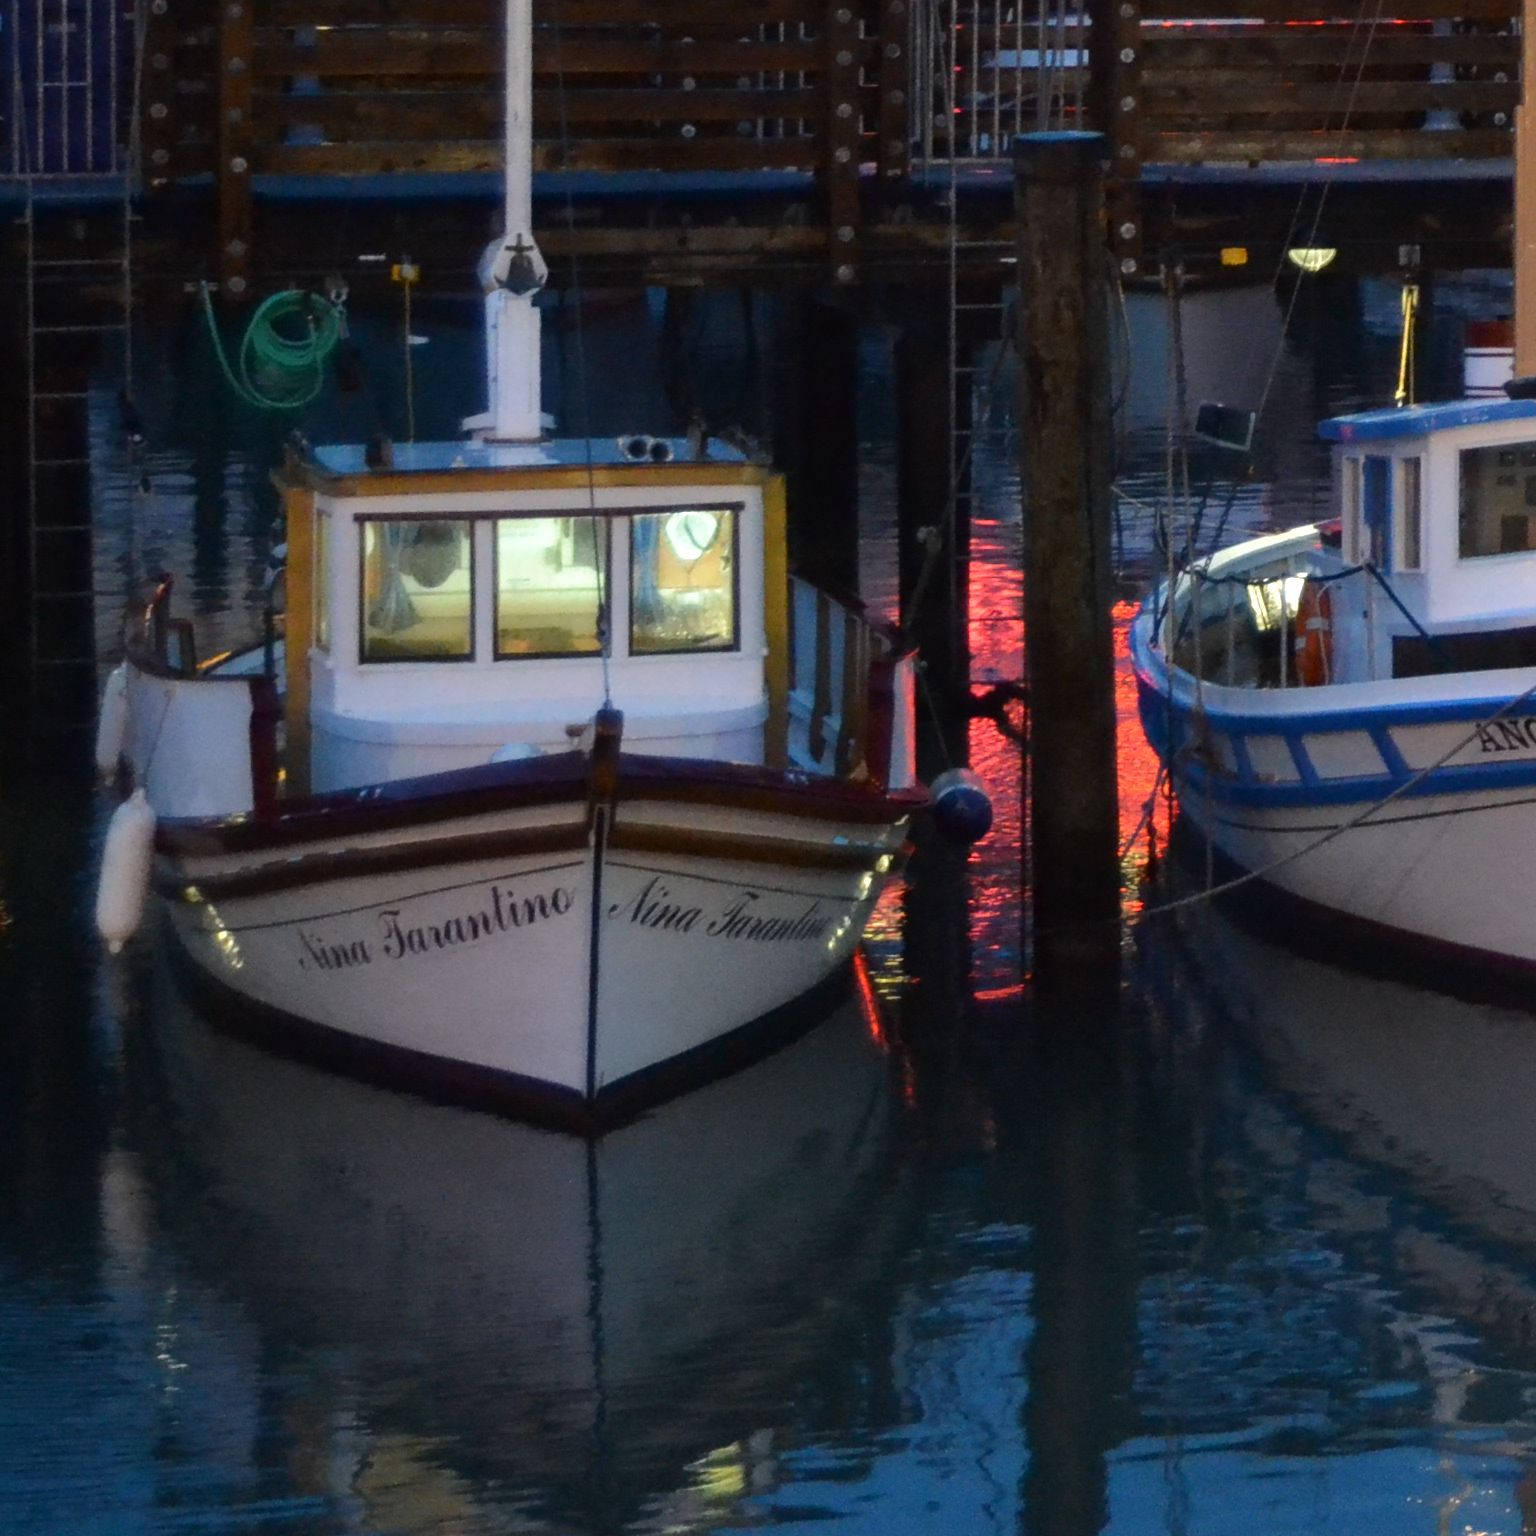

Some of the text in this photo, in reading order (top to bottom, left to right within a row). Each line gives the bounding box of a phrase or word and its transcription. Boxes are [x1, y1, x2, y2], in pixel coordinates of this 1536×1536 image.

[299, 885, 576, 970] Nina Tarantino
[608, 876, 702, 932] Nina
